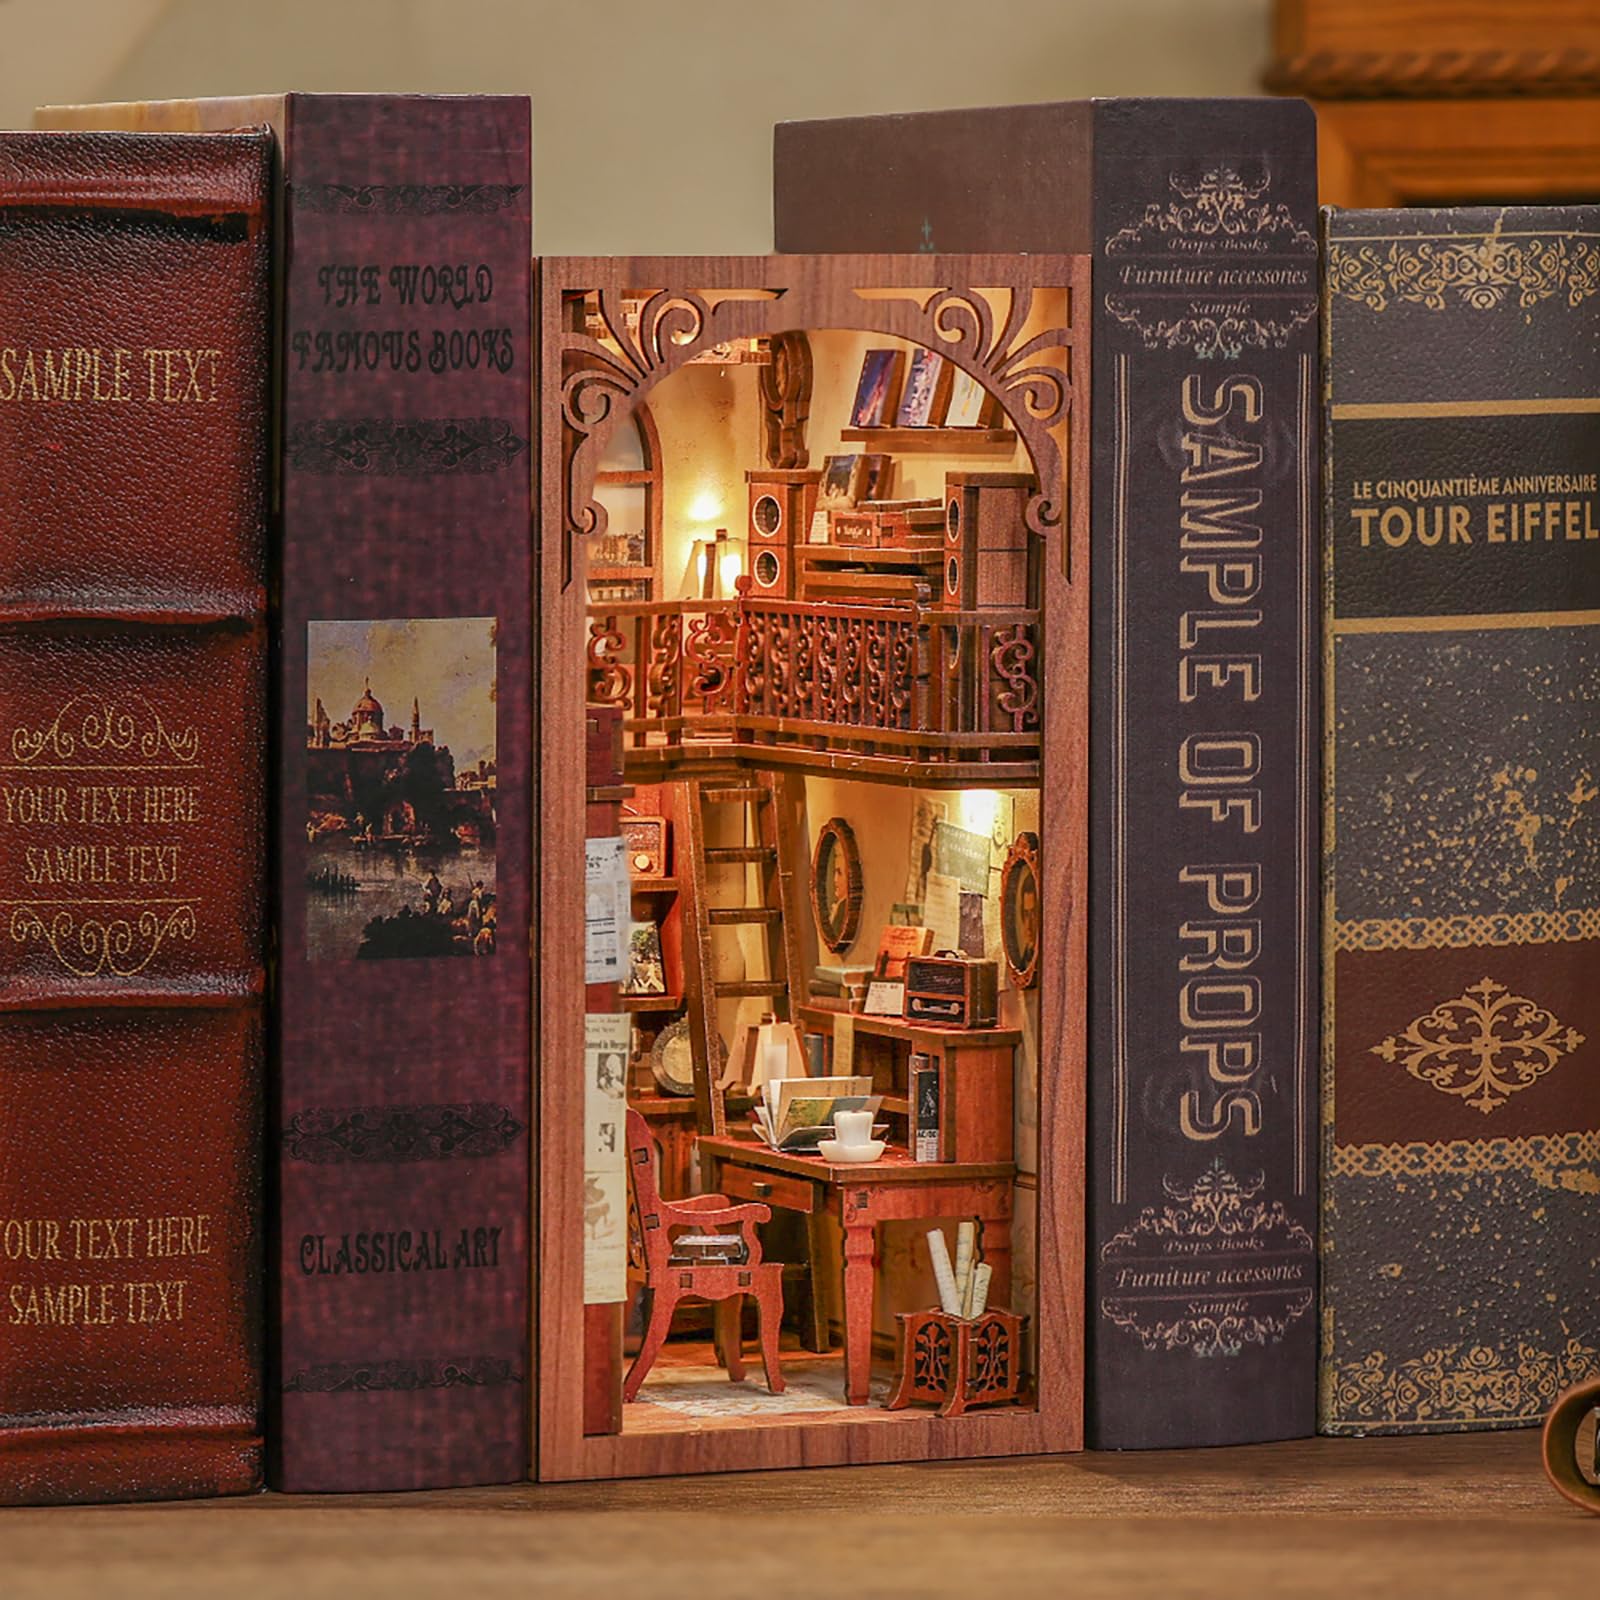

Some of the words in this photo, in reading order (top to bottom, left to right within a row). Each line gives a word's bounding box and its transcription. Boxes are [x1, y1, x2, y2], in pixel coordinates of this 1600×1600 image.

[1221, 236, 1268, 250] Books
[317, 264, 381, 308] THE
[389, 264, 493, 310] WORLD
[1119, 264, 1214, 285] Furniture
[1218, 264, 1308, 285] accessories
[1187, 299, 1250, 317] Sample
[292, 330, 421, 373] FAMOUS
[428, 328, 514, 374] BOOKS
[0, 347, 131, 401] SAMPLE
[143, 349, 221, 401] TEXT
[1353, 481, 1372, 499] LE
[1376, 474, 1500, 502] CINQUANTIÈME
[1502, 473, 1598, 495] ANNIVERSAIRE
[1179, 374, 1264, 702] SAMPLE
[1351, 505, 1473, 547] TOUR
[1488, 501, 1599, 543] EIFFEL
[1, 787, 69, 824] YOUR
[76, 786, 137, 824] TEXT
[143, 786, 201, 823] HERE
[1179, 732, 1262, 833] OF
[25, 847, 118, 883] SAMPLE
[125, 846, 181, 882] TEXT
[1179, 863, 1262, 1141] PROPS
[0, 1219, 61, 1260] OUR
[69, 1218, 138, 1259] TEXT
[147, 1214, 211, 1257] HERE
[300, 1229, 447, 1276] CLASSICAL
[454, 1226, 503, 1269] ART
[1217, 1235, 1264, 1250] Books
[1115, 1266, 1210, 1288] Furniture
[1216, 1259, 1302, 1284] accessories
[8, 1284, 117, 1325] SAMPLE
[123, 1280, 188, 1323] TEXT
[1185, 1299, 1248, 1316] Sample
